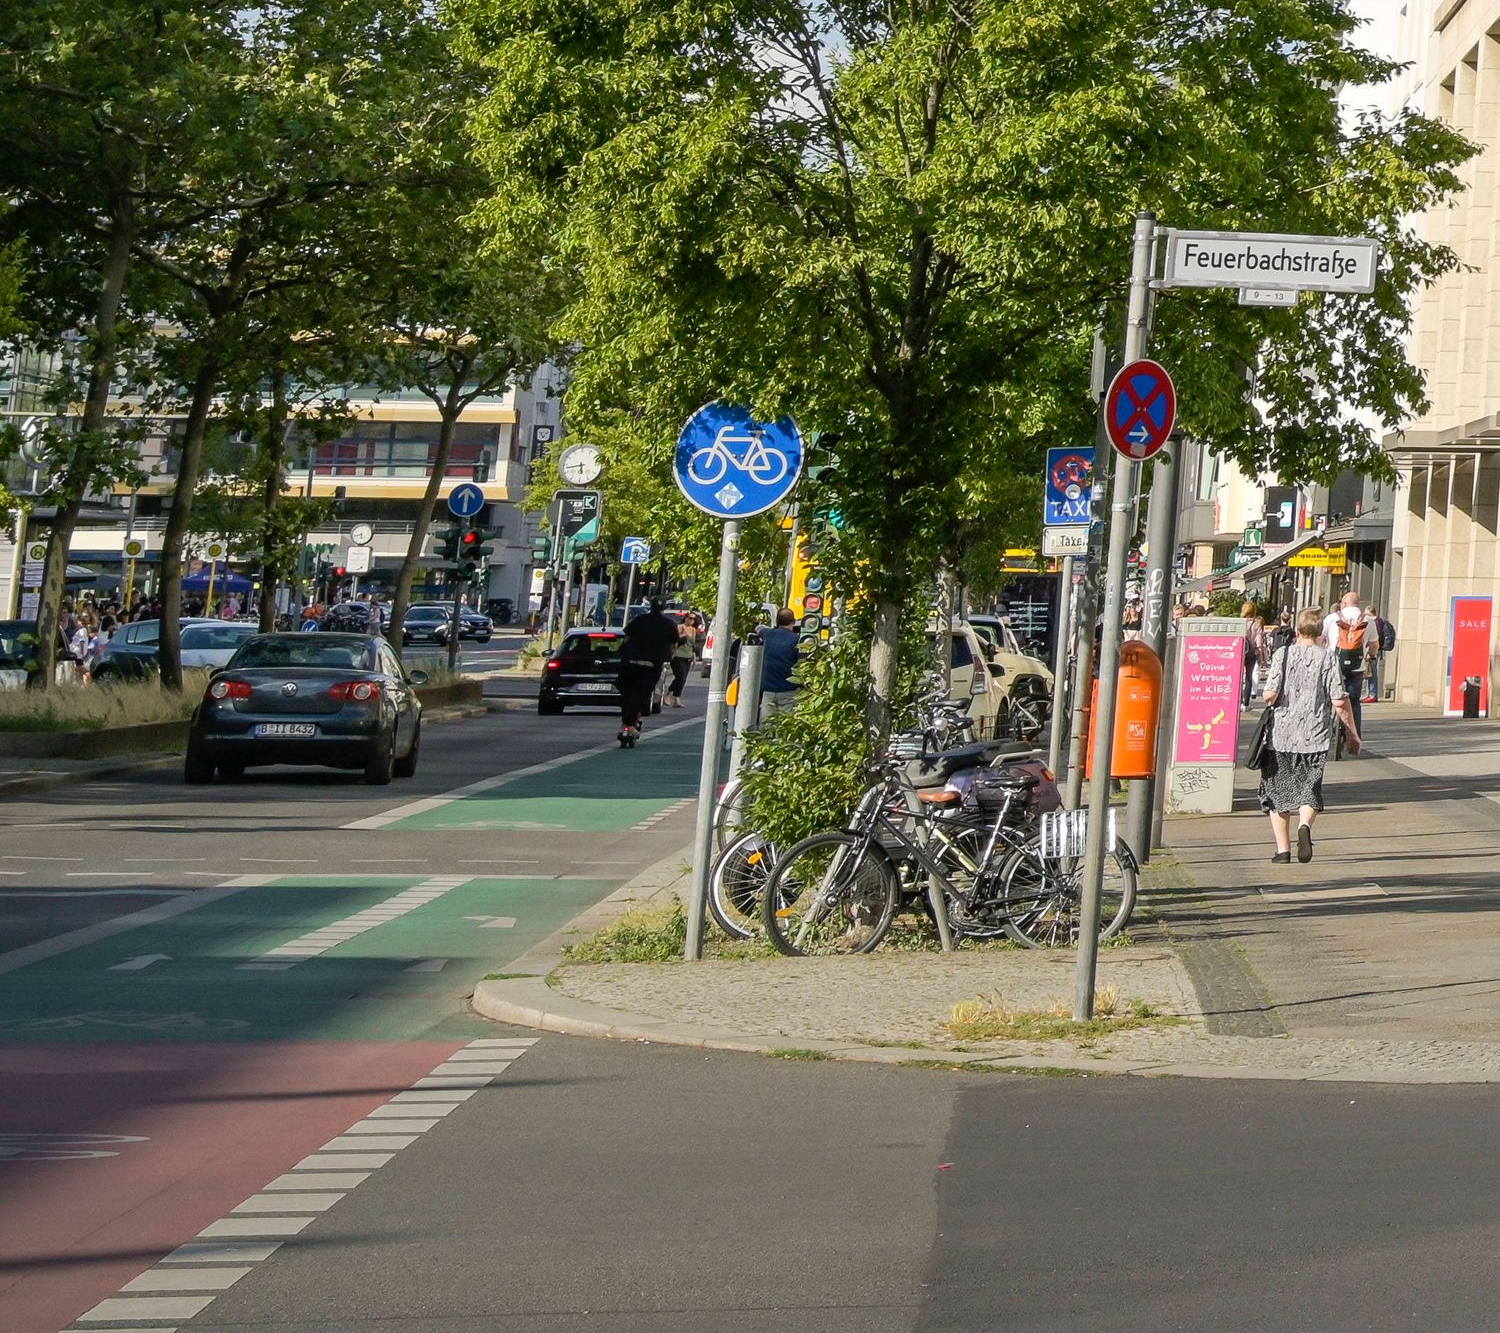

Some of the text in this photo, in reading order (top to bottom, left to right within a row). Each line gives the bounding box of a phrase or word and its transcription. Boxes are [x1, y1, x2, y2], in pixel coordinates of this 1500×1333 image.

[1184, 243, 1357, 279] Feuerbachstraße
[1274, 293, 1284, 301] 13
[1459, 620, 1487, 628] SALE
[1200, 662, 1225, 671] Deine
[1191, 674, 1232, 688] Werbung
[1189, 684, 1232, 693] im KIEZ
[261, 724, 268, 733] B
